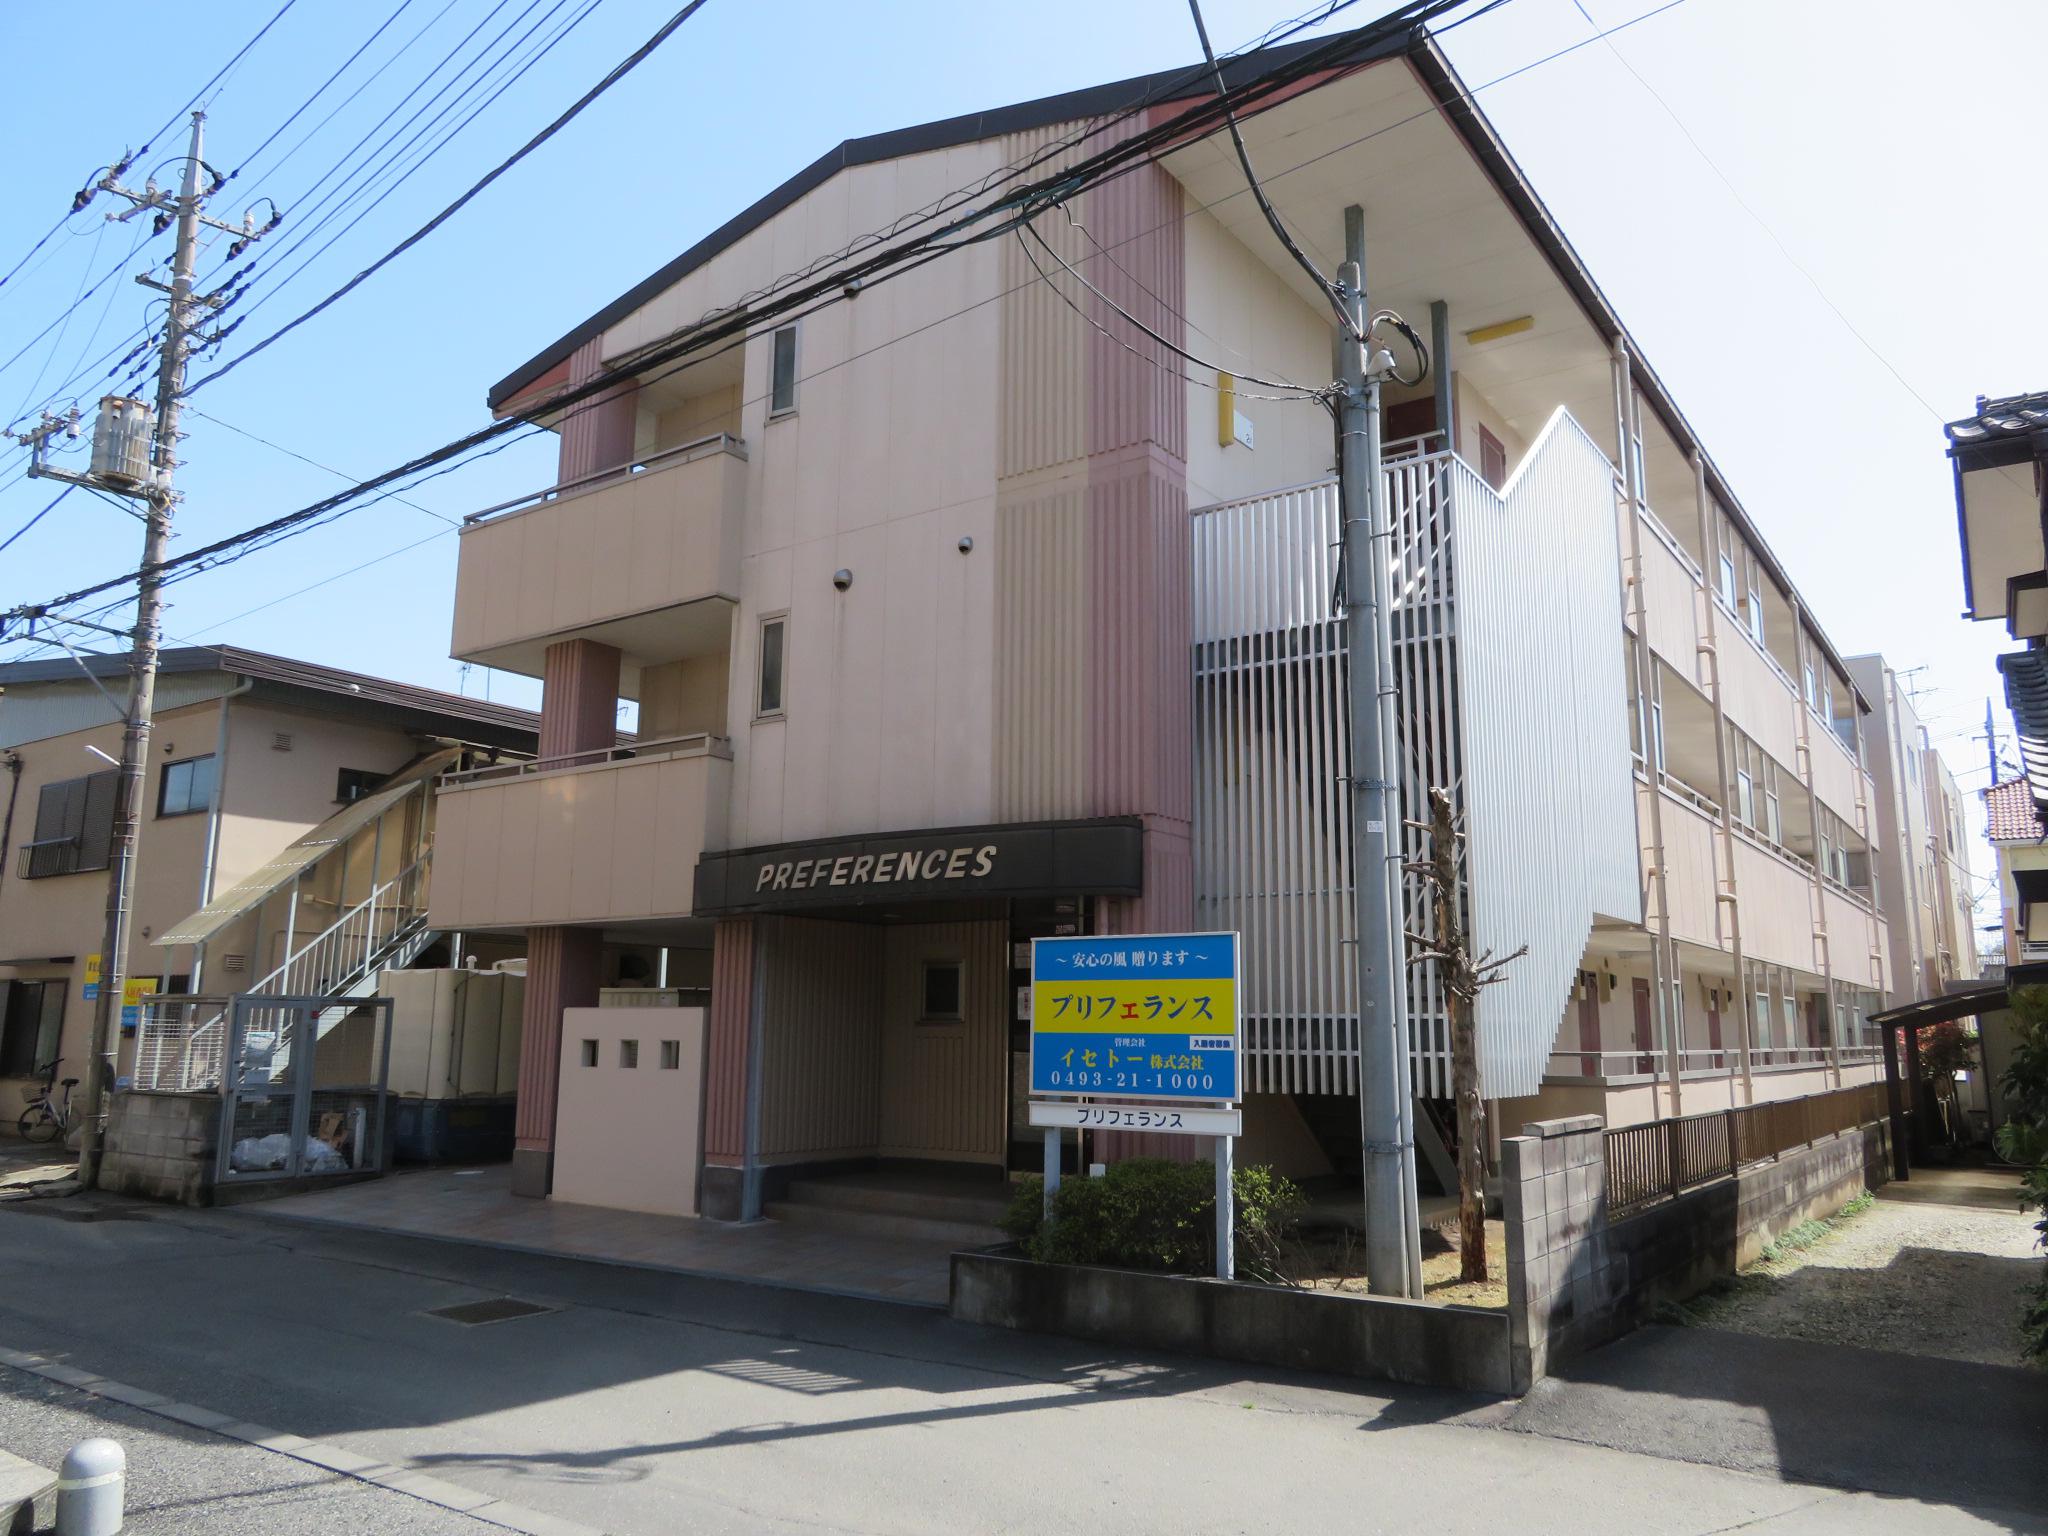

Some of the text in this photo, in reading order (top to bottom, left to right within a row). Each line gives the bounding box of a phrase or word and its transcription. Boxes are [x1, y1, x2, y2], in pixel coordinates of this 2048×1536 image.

[756, 846, 997, 892] PREFERENCES
[1052, 994, 1213, 1020] プリフェランス
[1051, 1071, 1213, 1090] 0493-21-1000
[1077, 1109, 1183, 1127] プリフェランス
